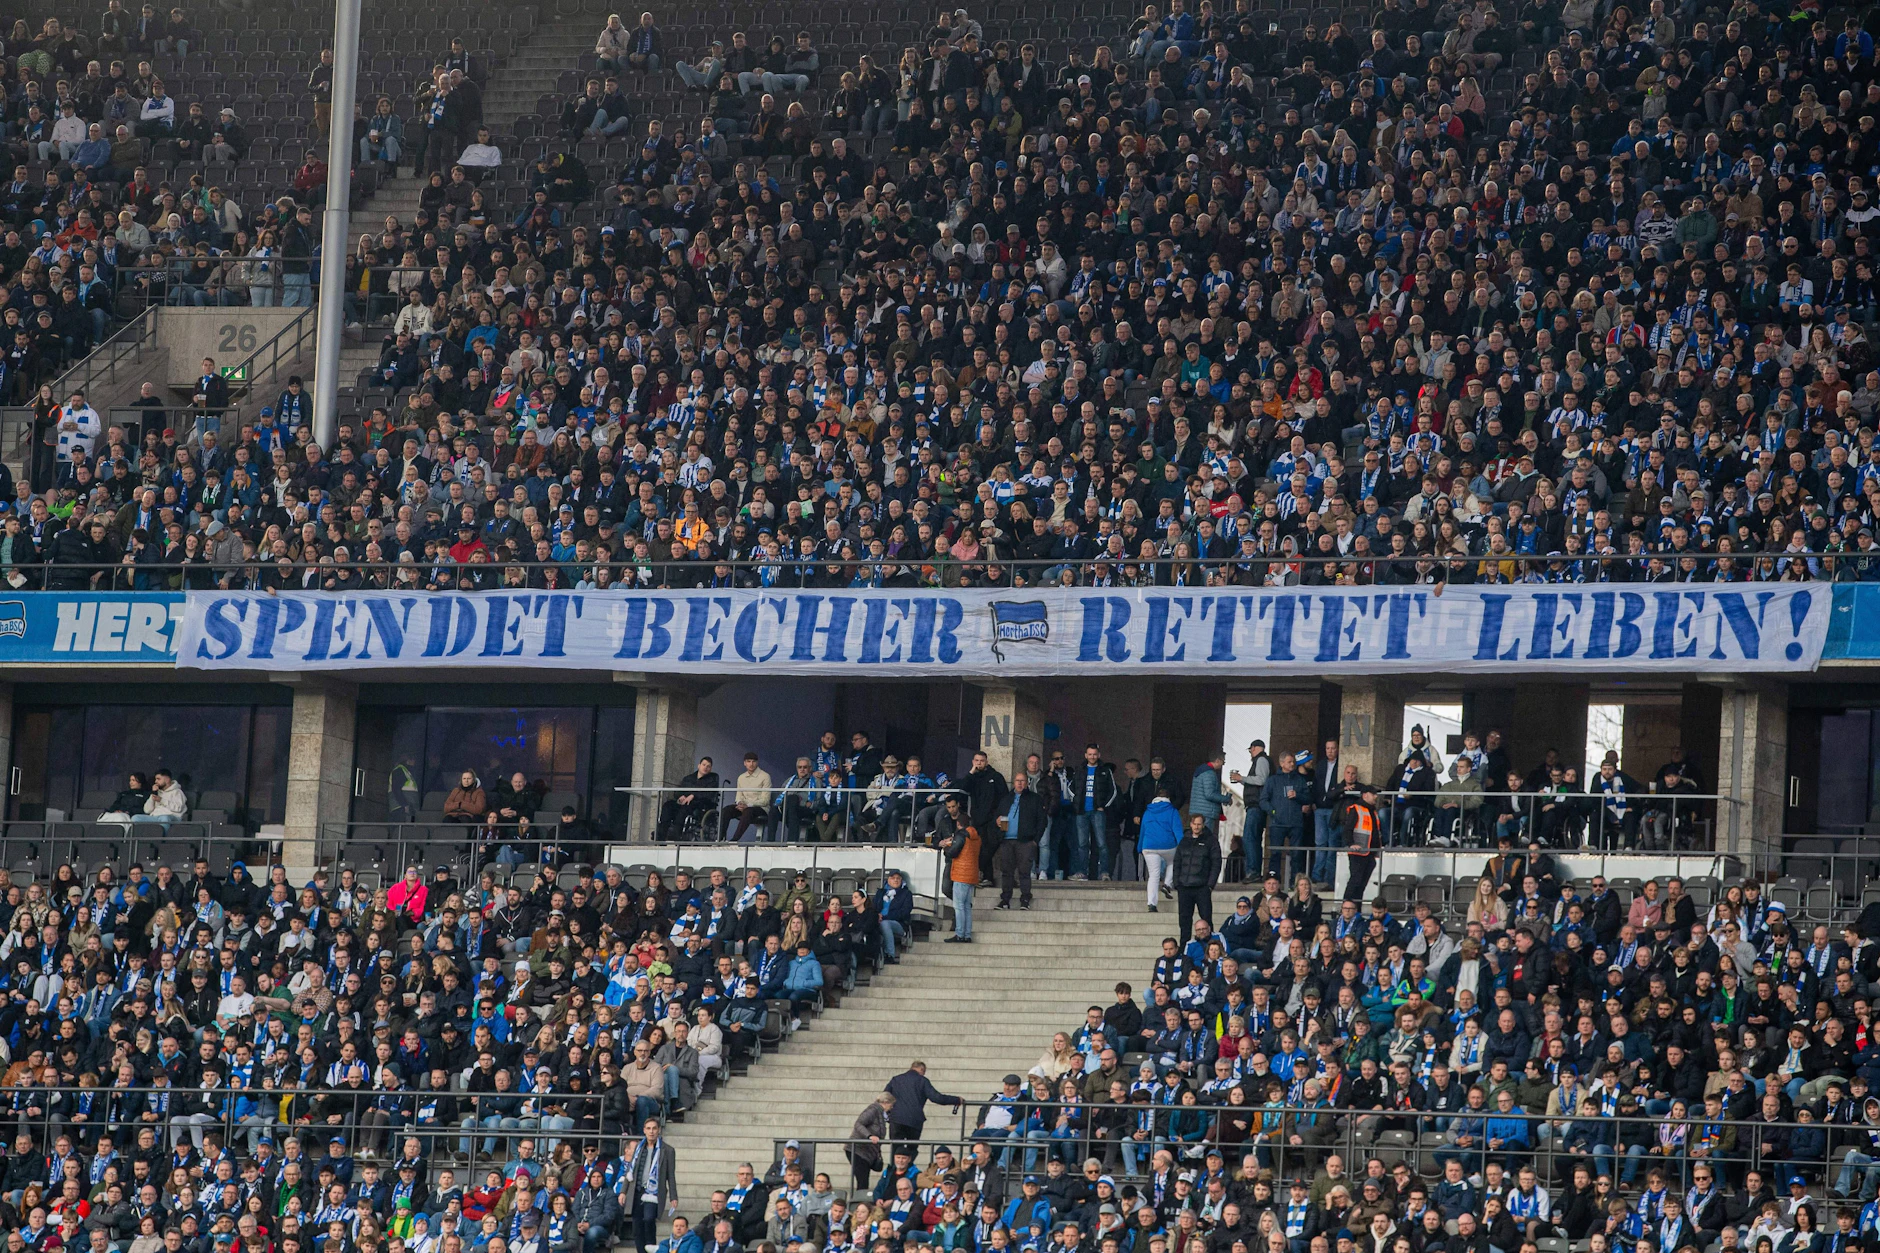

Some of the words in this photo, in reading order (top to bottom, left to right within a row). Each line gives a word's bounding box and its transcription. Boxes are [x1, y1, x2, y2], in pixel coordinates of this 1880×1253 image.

[218, 324, 257, 353] 26
[196, 594, 584, 661] SPENDET
[613, 594, 964, 664] BECHER
[1075, 593, 1427, 662] RETTET
[1472, 590, 1812, 661] LEBEN!
[985, 715, 1010, 746] N
[1344, 714, 1370, 746] N
